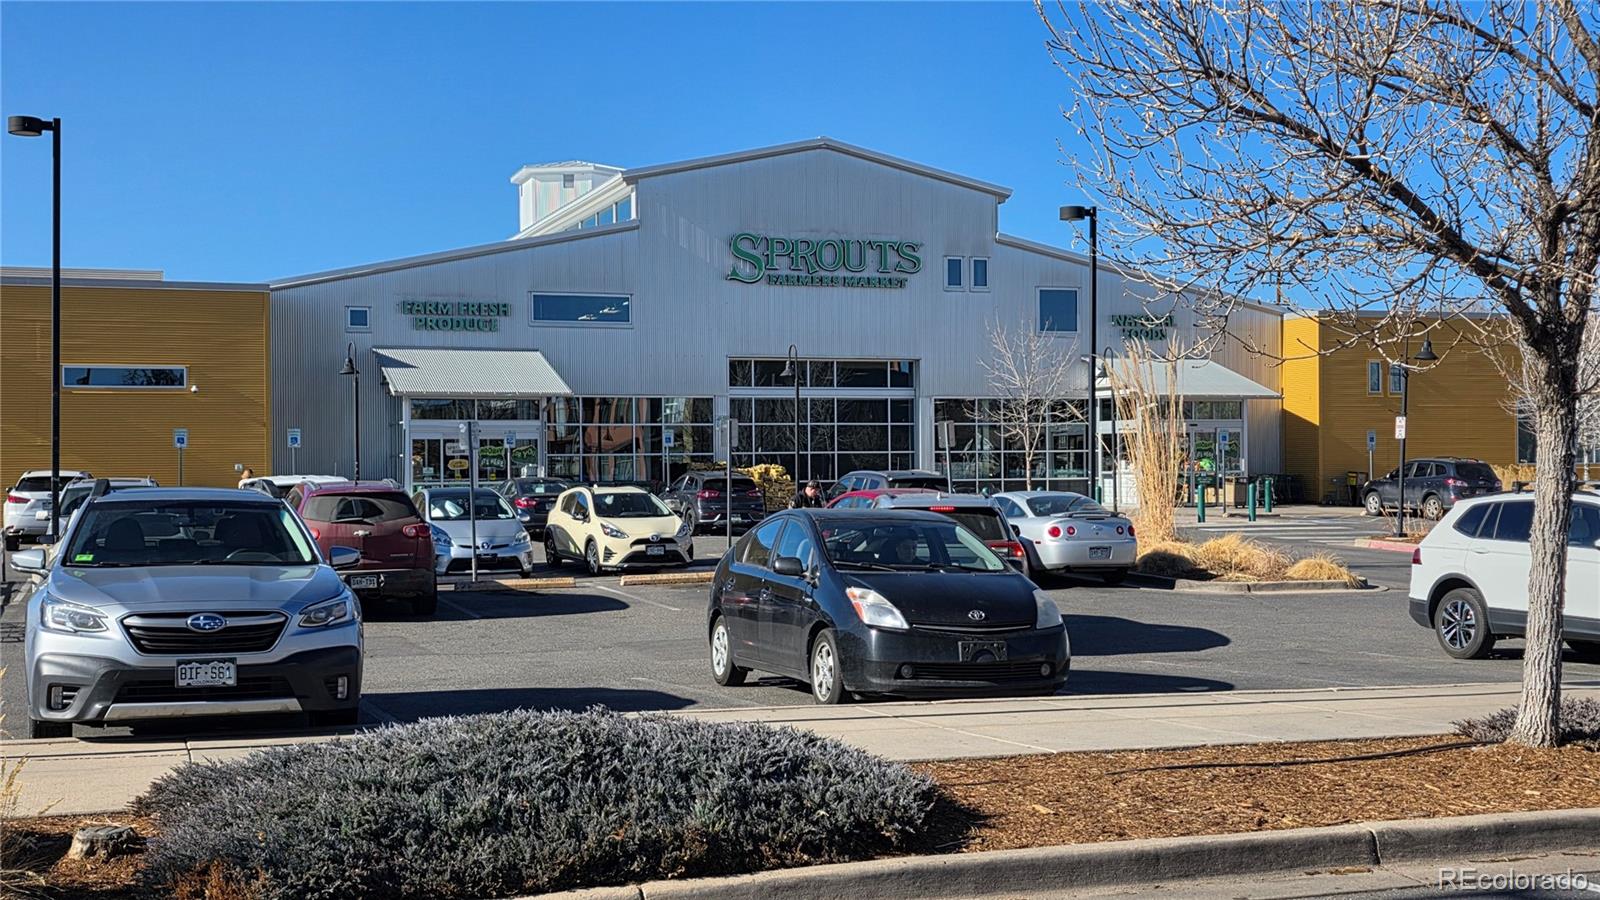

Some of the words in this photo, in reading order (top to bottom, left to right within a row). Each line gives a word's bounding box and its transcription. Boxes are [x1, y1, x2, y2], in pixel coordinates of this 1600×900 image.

[727, 232, 923, 284] SPROUTS
[767, 273, 840, 287] FARMERS
[843, 275, 908, 289] MARKET
[401, 300, 453, 316] FARM
[457, 302, 511, 317] FRESH
[413, 317, 498, 332] PRODUCE
